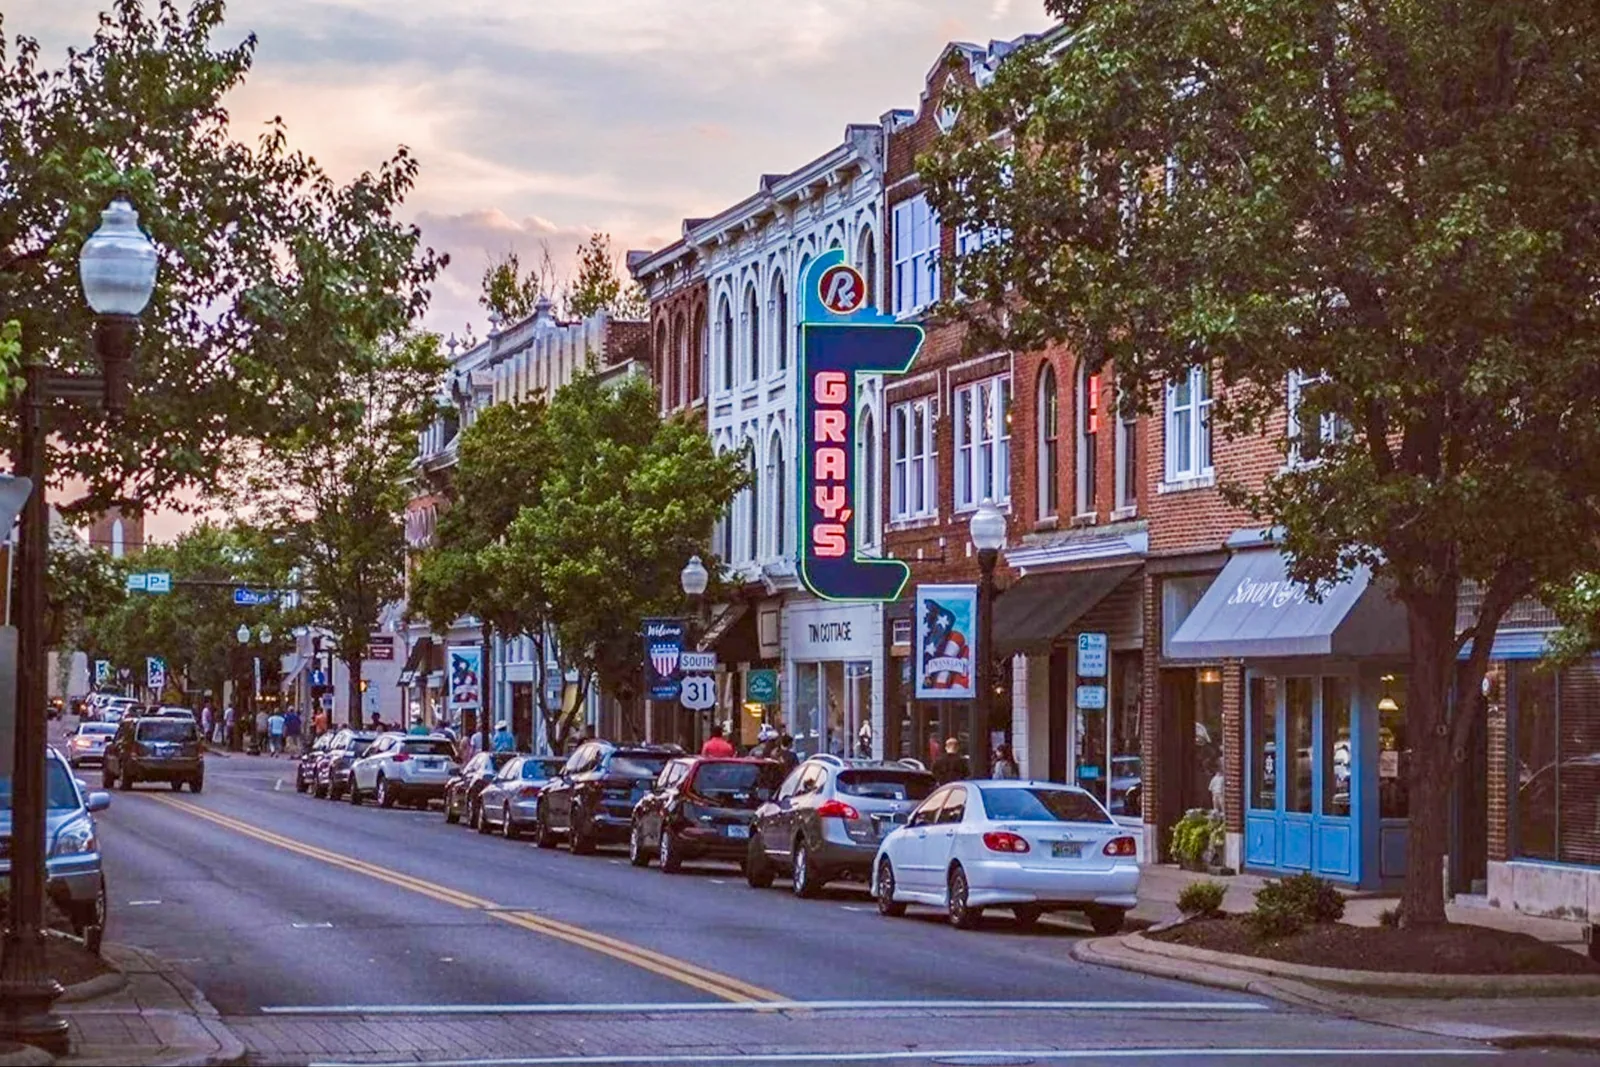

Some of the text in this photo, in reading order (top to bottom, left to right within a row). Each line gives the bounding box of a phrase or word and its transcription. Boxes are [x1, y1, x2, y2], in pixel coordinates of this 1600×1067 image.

[813, 371, 852, 557] GRAY'S
[808, 621, 852, 643] TIN COTTAGE
[682, 655, 713, 668] SOUTH
[687, 682, 707, 701] 31
